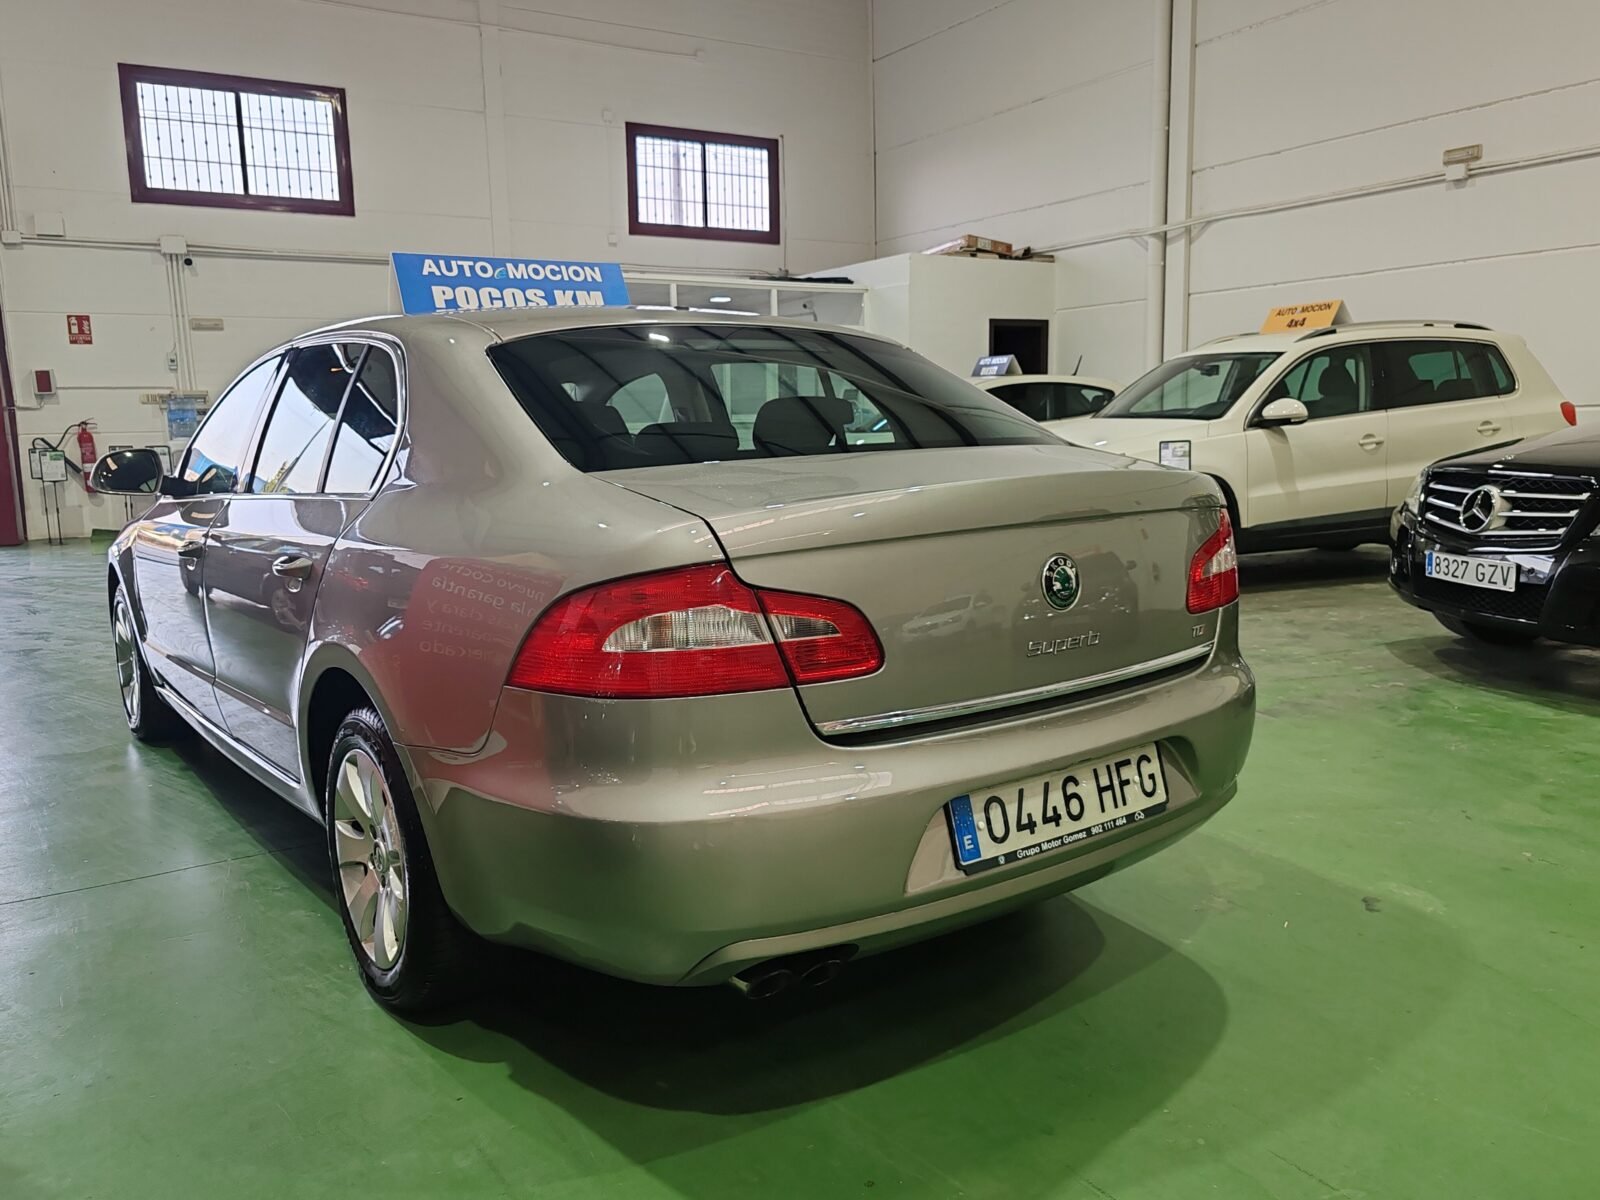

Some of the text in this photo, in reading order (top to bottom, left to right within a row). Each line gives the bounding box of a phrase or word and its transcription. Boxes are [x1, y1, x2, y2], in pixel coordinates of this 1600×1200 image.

[431, 285, 605, 309] POCOS KM
[1286, 317, 1307, 328] 4x4
[1434, 555, 1510, 586] 8327 GZV
[1026, 630, 1100, 657] Superb
[983, 753, 1157, 844] 0446 HFG
[1016, 845, 1040, 859] Grupo
[1041, 838, 1062, 854] Motor
[1062, 830, 1087, 844] Gomez
[1090, 824, 1103, 835] 902
[1104, 820, 1114, 832] 111
